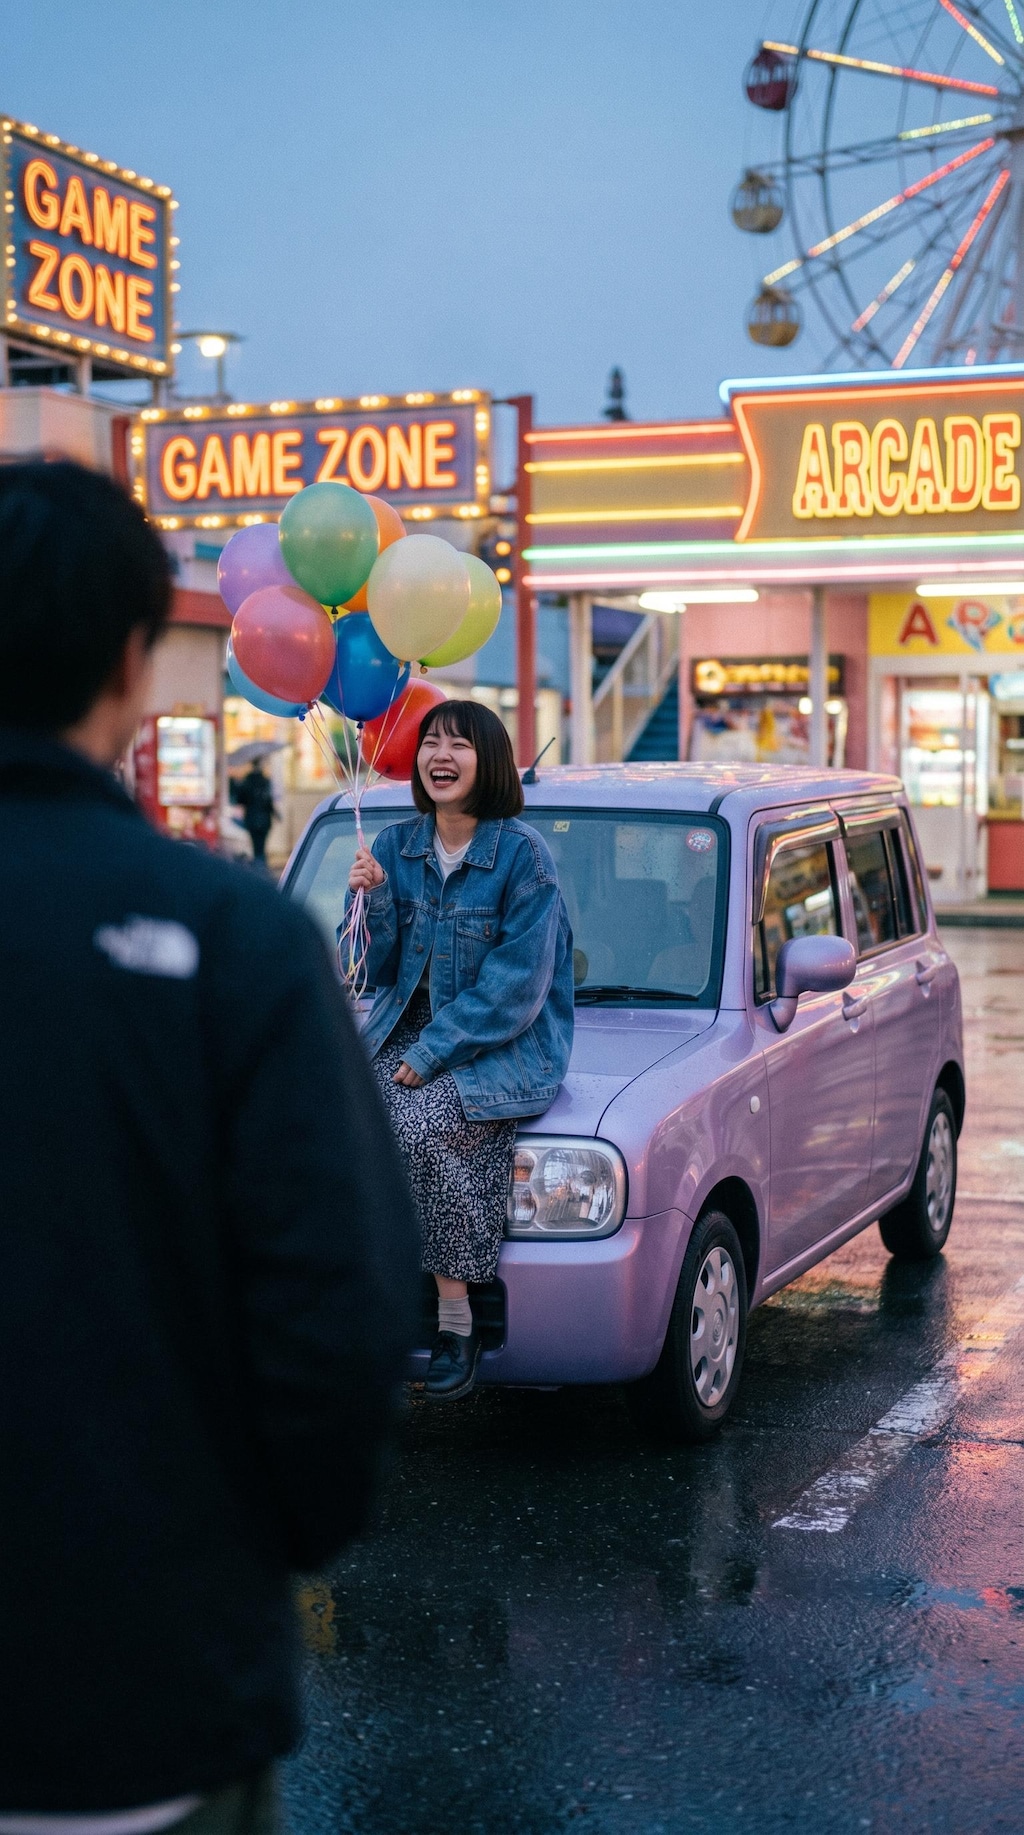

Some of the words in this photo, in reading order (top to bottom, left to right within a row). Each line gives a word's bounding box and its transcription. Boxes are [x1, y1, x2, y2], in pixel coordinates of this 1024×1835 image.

[25, 159, 157, 269] GAME
[29, 240, 155, 341] ZONE
[161, 430, 303, 500] GAME
[316, 420, 455, 491] ZONE
[792, 413, 1021, 518] ARCADE
